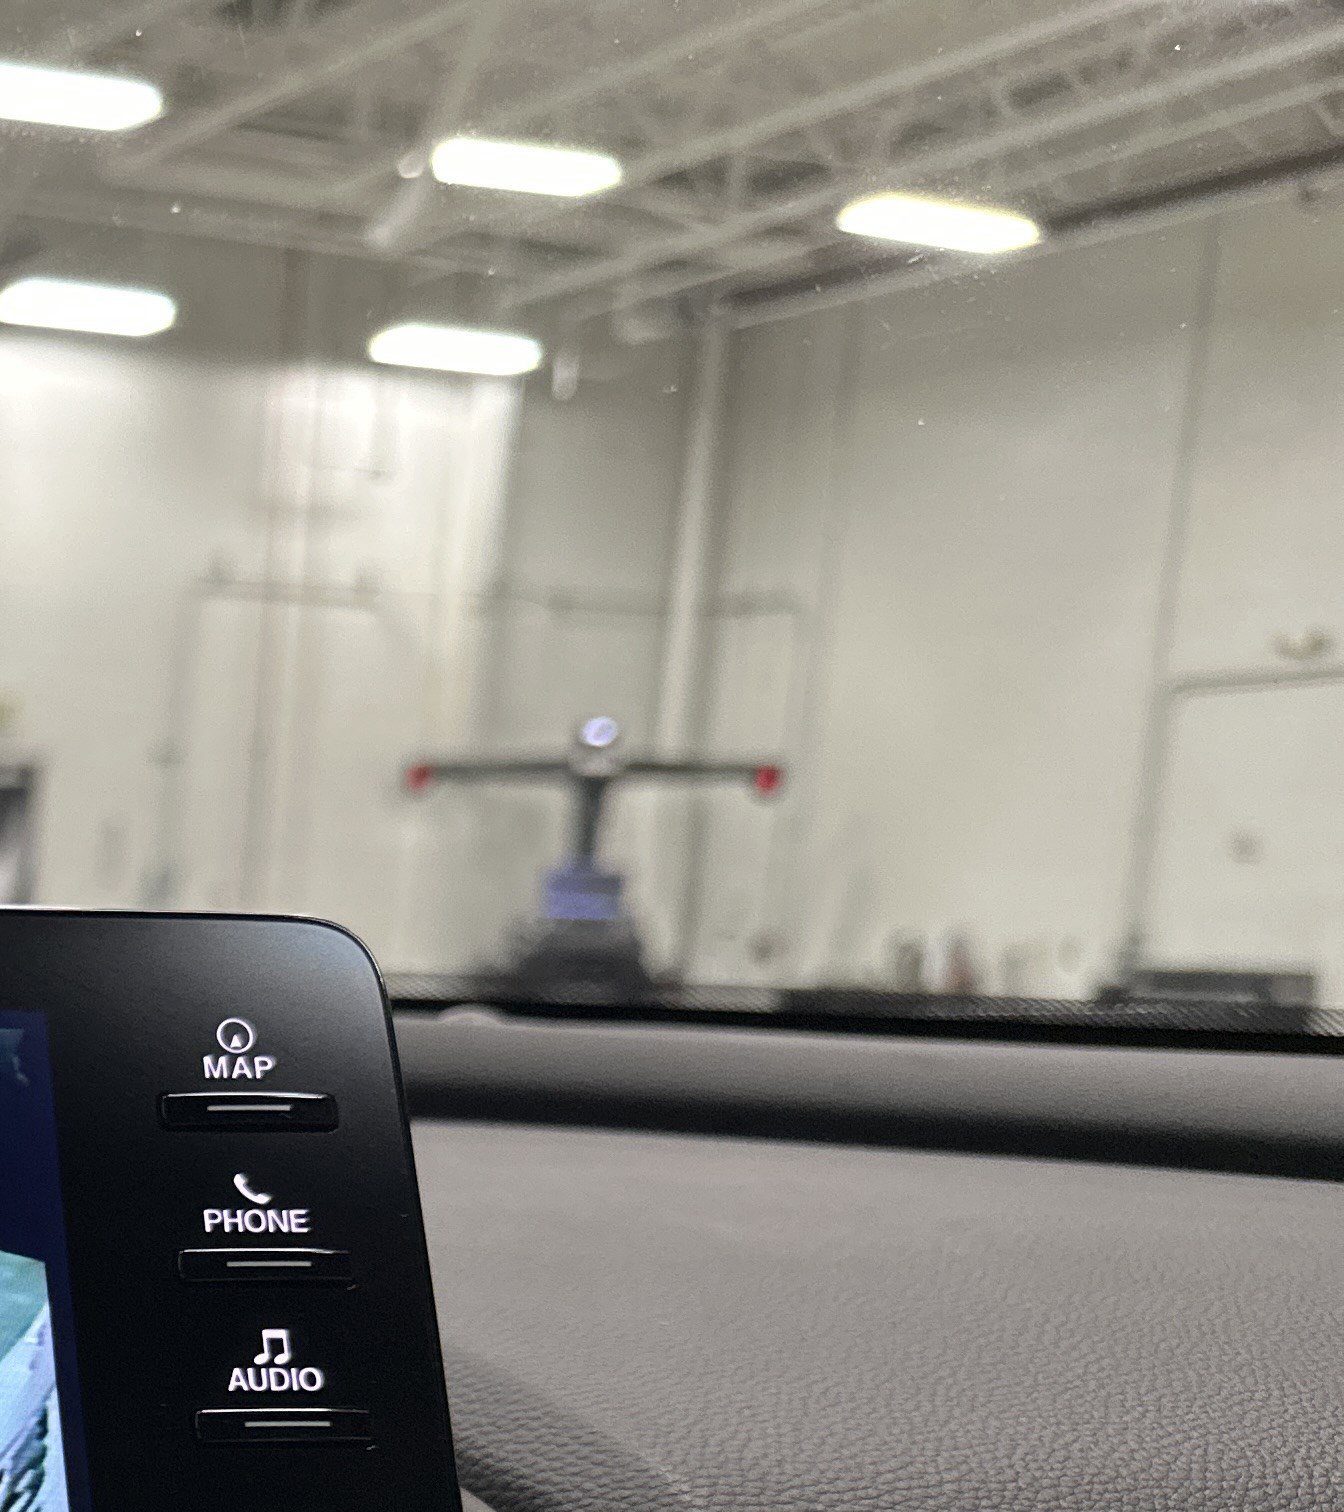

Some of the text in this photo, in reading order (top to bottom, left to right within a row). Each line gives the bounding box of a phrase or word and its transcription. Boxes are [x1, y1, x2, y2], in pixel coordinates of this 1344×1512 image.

[202, 1054, 276, 1080] MAP
[203, 1208, 310, 1234] PHONE
[227, 1367, 325, 1392] AUDIO
